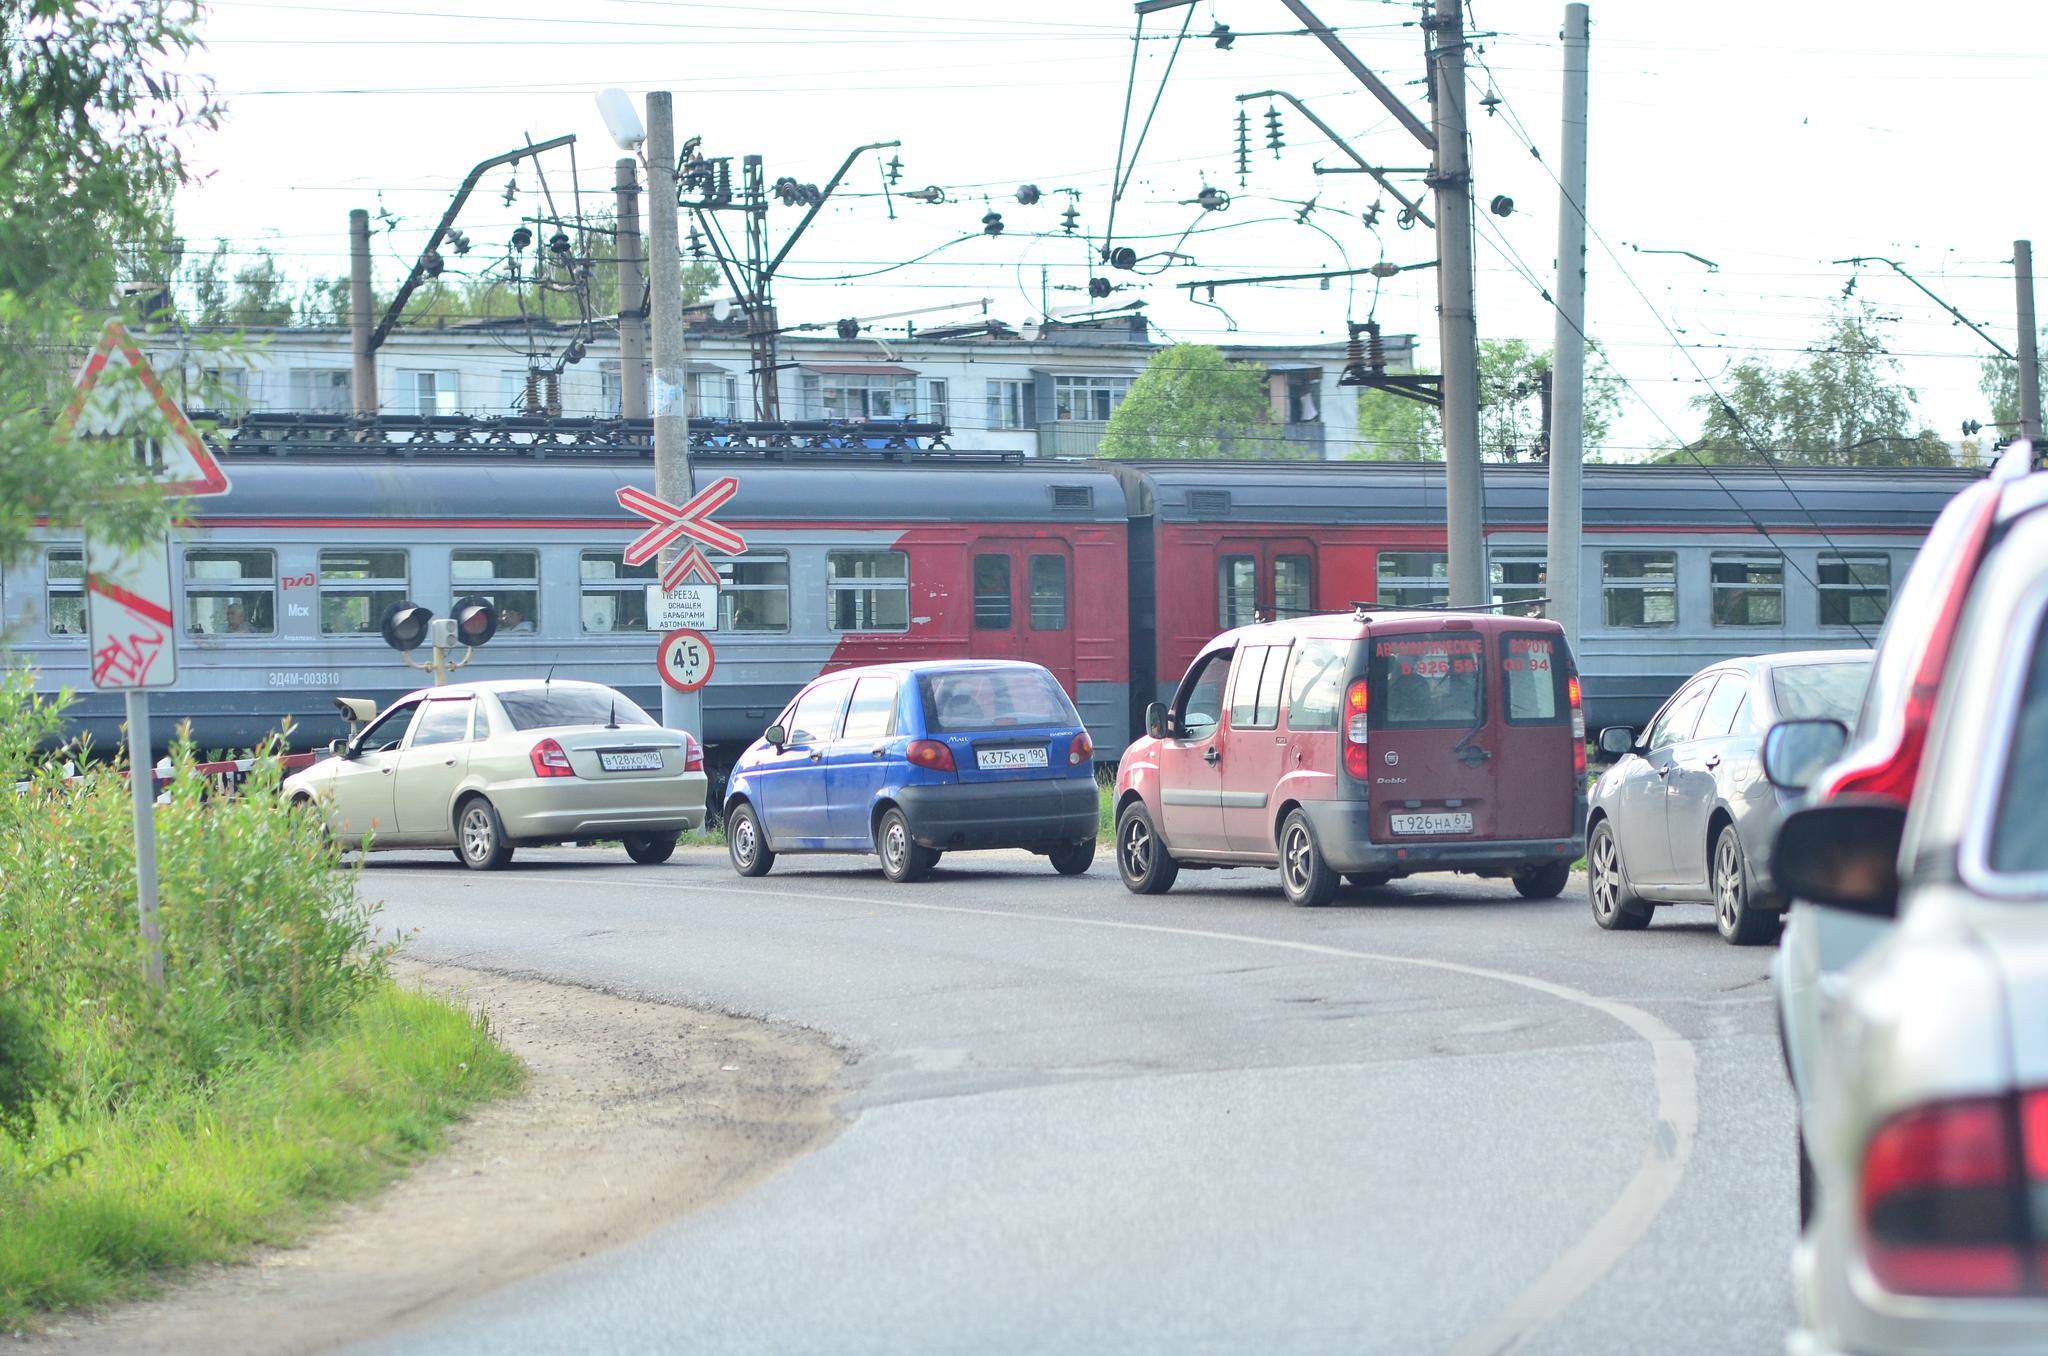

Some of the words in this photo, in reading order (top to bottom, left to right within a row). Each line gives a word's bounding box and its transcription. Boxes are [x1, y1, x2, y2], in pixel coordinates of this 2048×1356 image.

[288, 603, 310, 617] Мск
[659, 620, 705, 628] АВТОМАТИКИ
[1416, 660, 1449, 674] 926
[1529, 659, 1548, 672] 94
[268, 672, 341, 686] ЭД4М-003810
